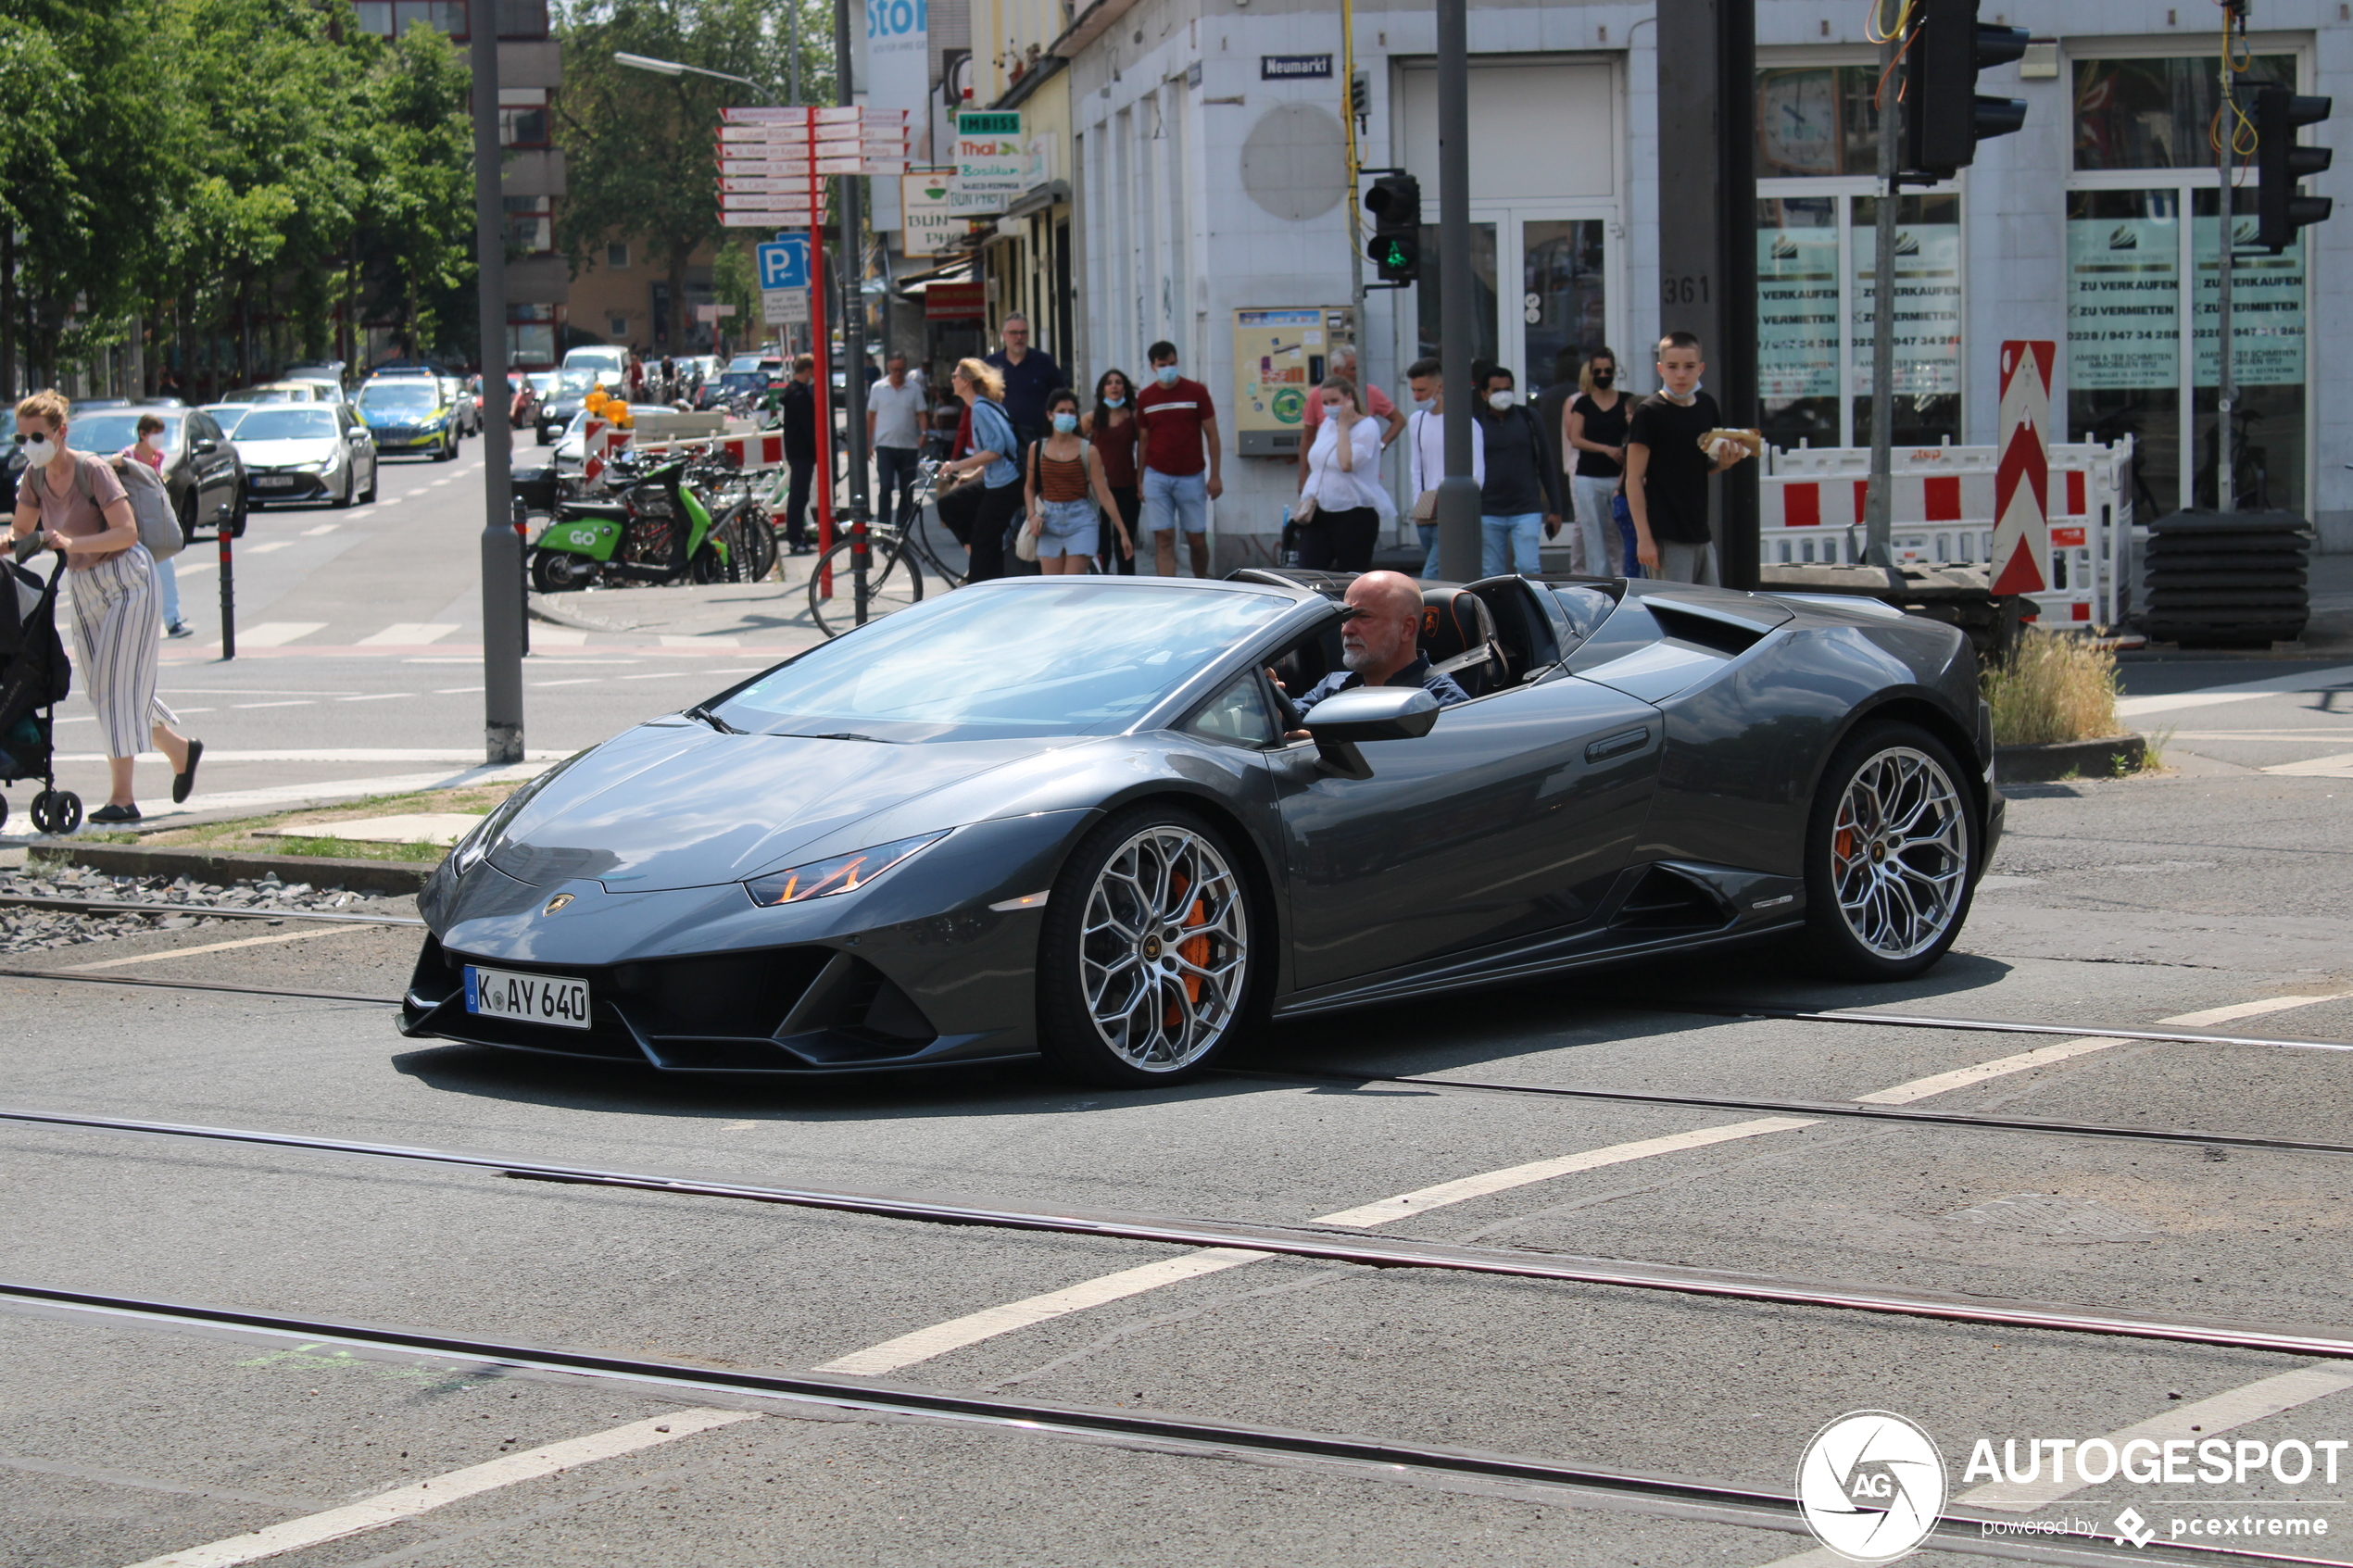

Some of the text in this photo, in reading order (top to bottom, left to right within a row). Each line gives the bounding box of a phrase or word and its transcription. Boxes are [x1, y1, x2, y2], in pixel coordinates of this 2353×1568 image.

[1266, 57, 1327, 73] Neumarkt
[961, 117, 1018, 132] IMBISS
[962, 164, 1019, 177] Basilikum
[765, 248, 790, 284] P
[2080, 280, 2178, 291] ZU VERKAUFEN
[2232, 277, 2302, 287] ERKAUFEN
[1664, 275, 1708, 305] 361
[1762, 289, 1839, 300] VERKAUFEN
[1894, 286, 1960, 297] ERKAUFEN
[2080, 305, 2174, 316] ZU VERMIETEN
[2233, 301, 2298, 312] ERMIETEN
[1763, 315, 1835, 325] VERMIETEN
[1894, 311, 1957, 322] ERMIETEN
[2067, 330, 2180, 341] 0228 / 947 34 288
[2233, 327, 2257, 337] 947
[1893, 336, 1917, 345] 947
[1920, 336, 1935, 345] 34
[2126, 353, 2171, 361] SCHMITTEN
[570, 530, 596, 546] GO
[470, 995, 475, 1004] D
[478, 973, 585, 1021] K AY 640
